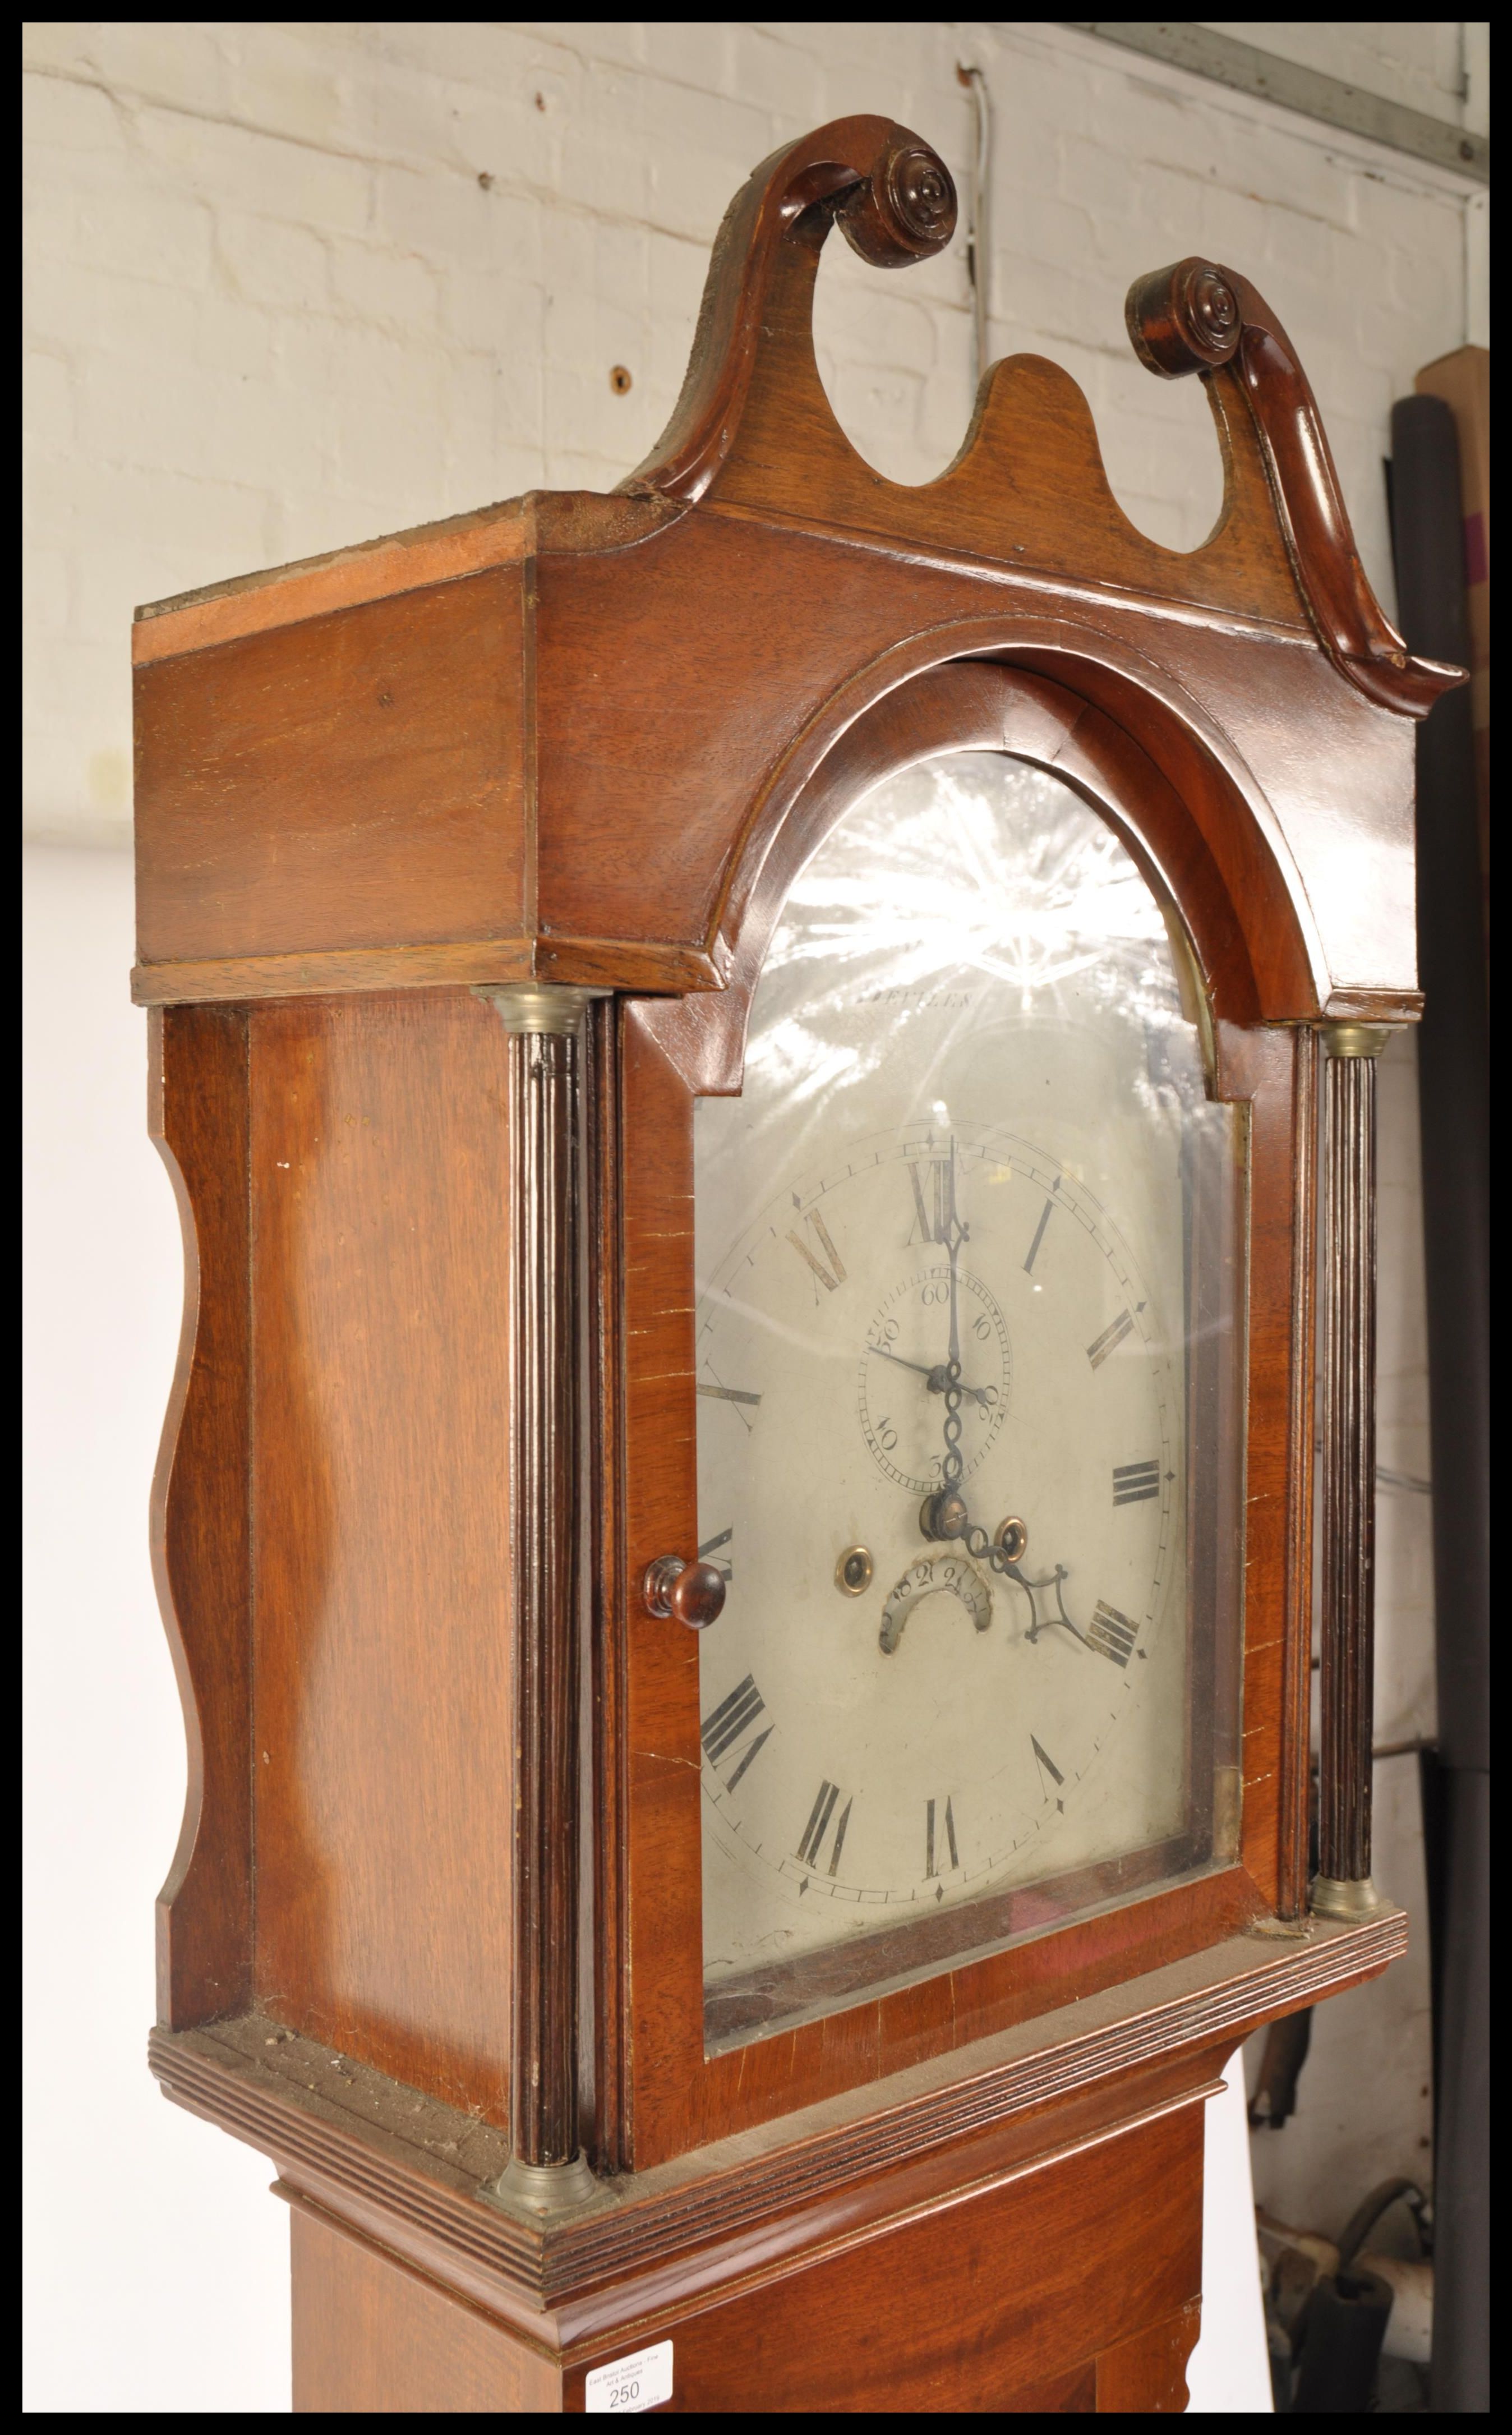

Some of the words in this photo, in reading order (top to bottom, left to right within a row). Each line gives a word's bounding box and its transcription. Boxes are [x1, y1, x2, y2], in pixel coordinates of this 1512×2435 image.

[899, 1160, 955, 1248] XII
[1020, 1196, 1058, 1277] I
[921, 1281, 949, 1306] 60
[876, 1319, 900, 1361] 50
[972, 1313, 991, 1341] 10
[1086, 1308, 1135, 1372] II
[979, 1385, 999, 1425] 20
[875, 1416, 898, 1451] 40
[1112, 1460, 1160, 1507] III
[589, 2377, 602, 2386] East
[603, 2369, 620, 2381] Bristol
[620, 2360, 643, 2373] Auctions
[620, 2368, 643, 2381] Antiques
[610, 2381, 640, 2409] 250
